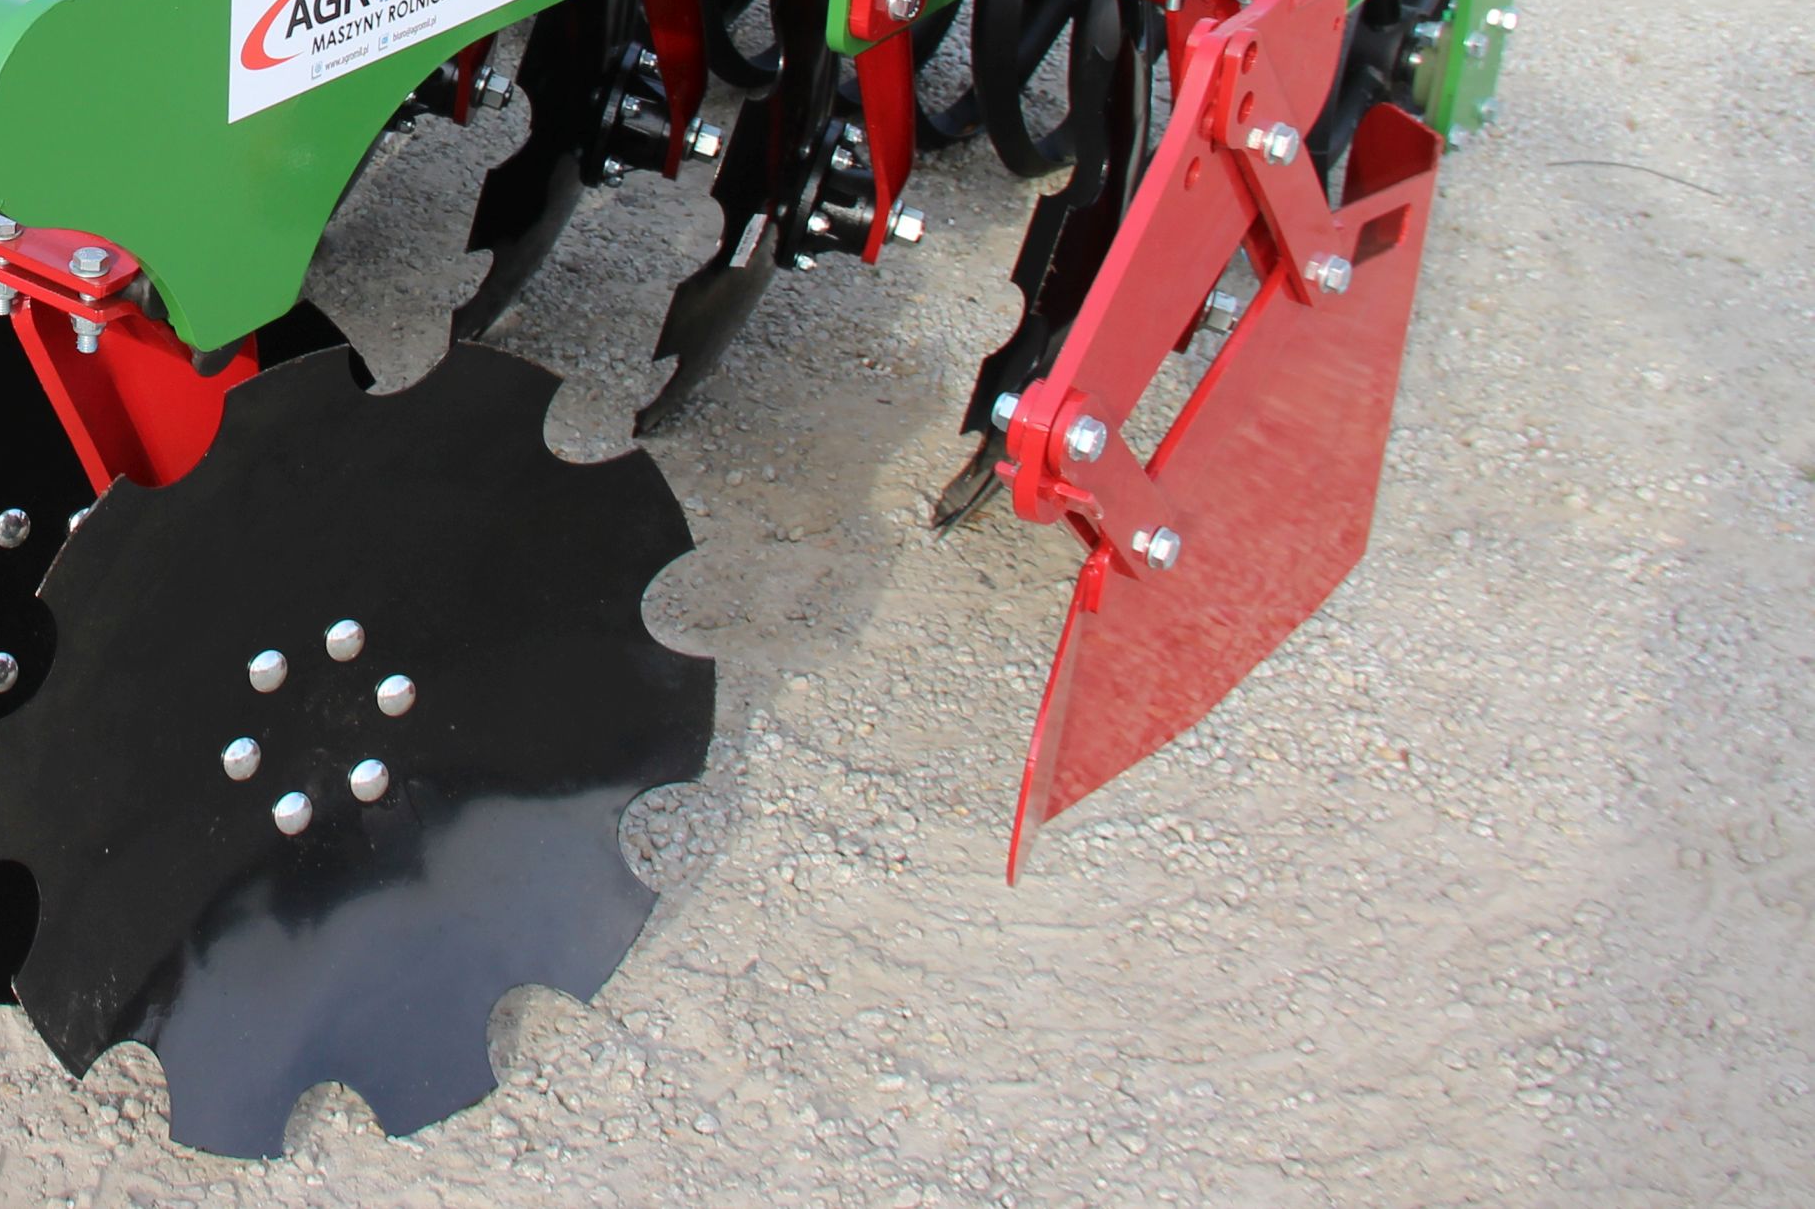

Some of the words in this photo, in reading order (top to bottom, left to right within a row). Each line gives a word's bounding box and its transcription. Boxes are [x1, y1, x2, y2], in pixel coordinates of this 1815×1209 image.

[311, 9, 384, 56] MASZYNY
[392, 15, 437, 42] biuro@agromil.pl
[324, 43, 370, 71] www.agromil.pl
